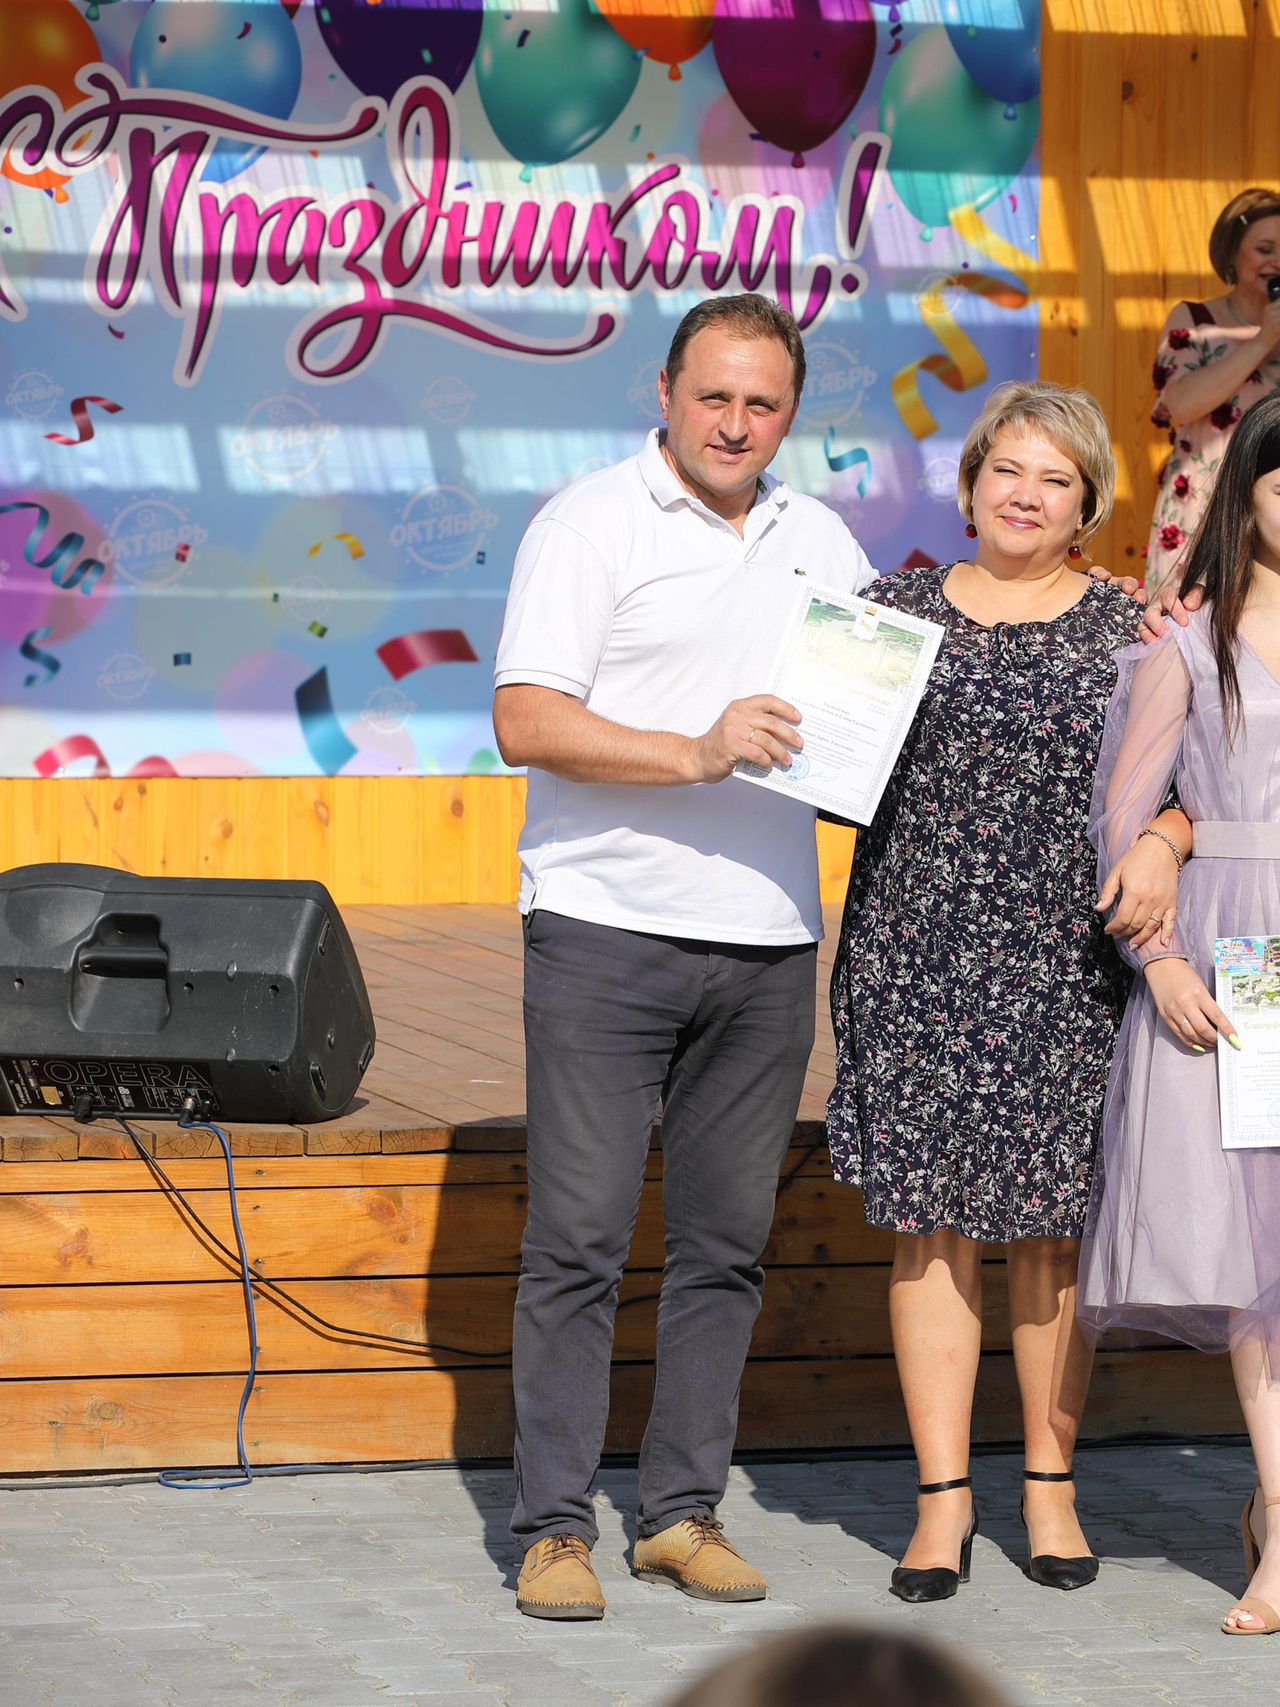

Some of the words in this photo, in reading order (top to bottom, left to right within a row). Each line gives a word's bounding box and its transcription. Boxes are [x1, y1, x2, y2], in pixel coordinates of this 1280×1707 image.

[57, 73, 881, 378] Праздником!
[5, 384, 64, 406] ОКТЯБРЬ
[804, 365, 877, 398] ТЯБРЬ
[230, 419, 340, 457] ОКТЯБРЬ
[917, 471, 957, 490] ОКТЯ
[97, 523, 209, 563] ОКТЯБРЬ
[390, 508, 499, 547] ОКТЯБРЬ
[96, 665, 157, 688] ОКТЯБРЬ
[43, 1060, 212, 1088] OPERA
